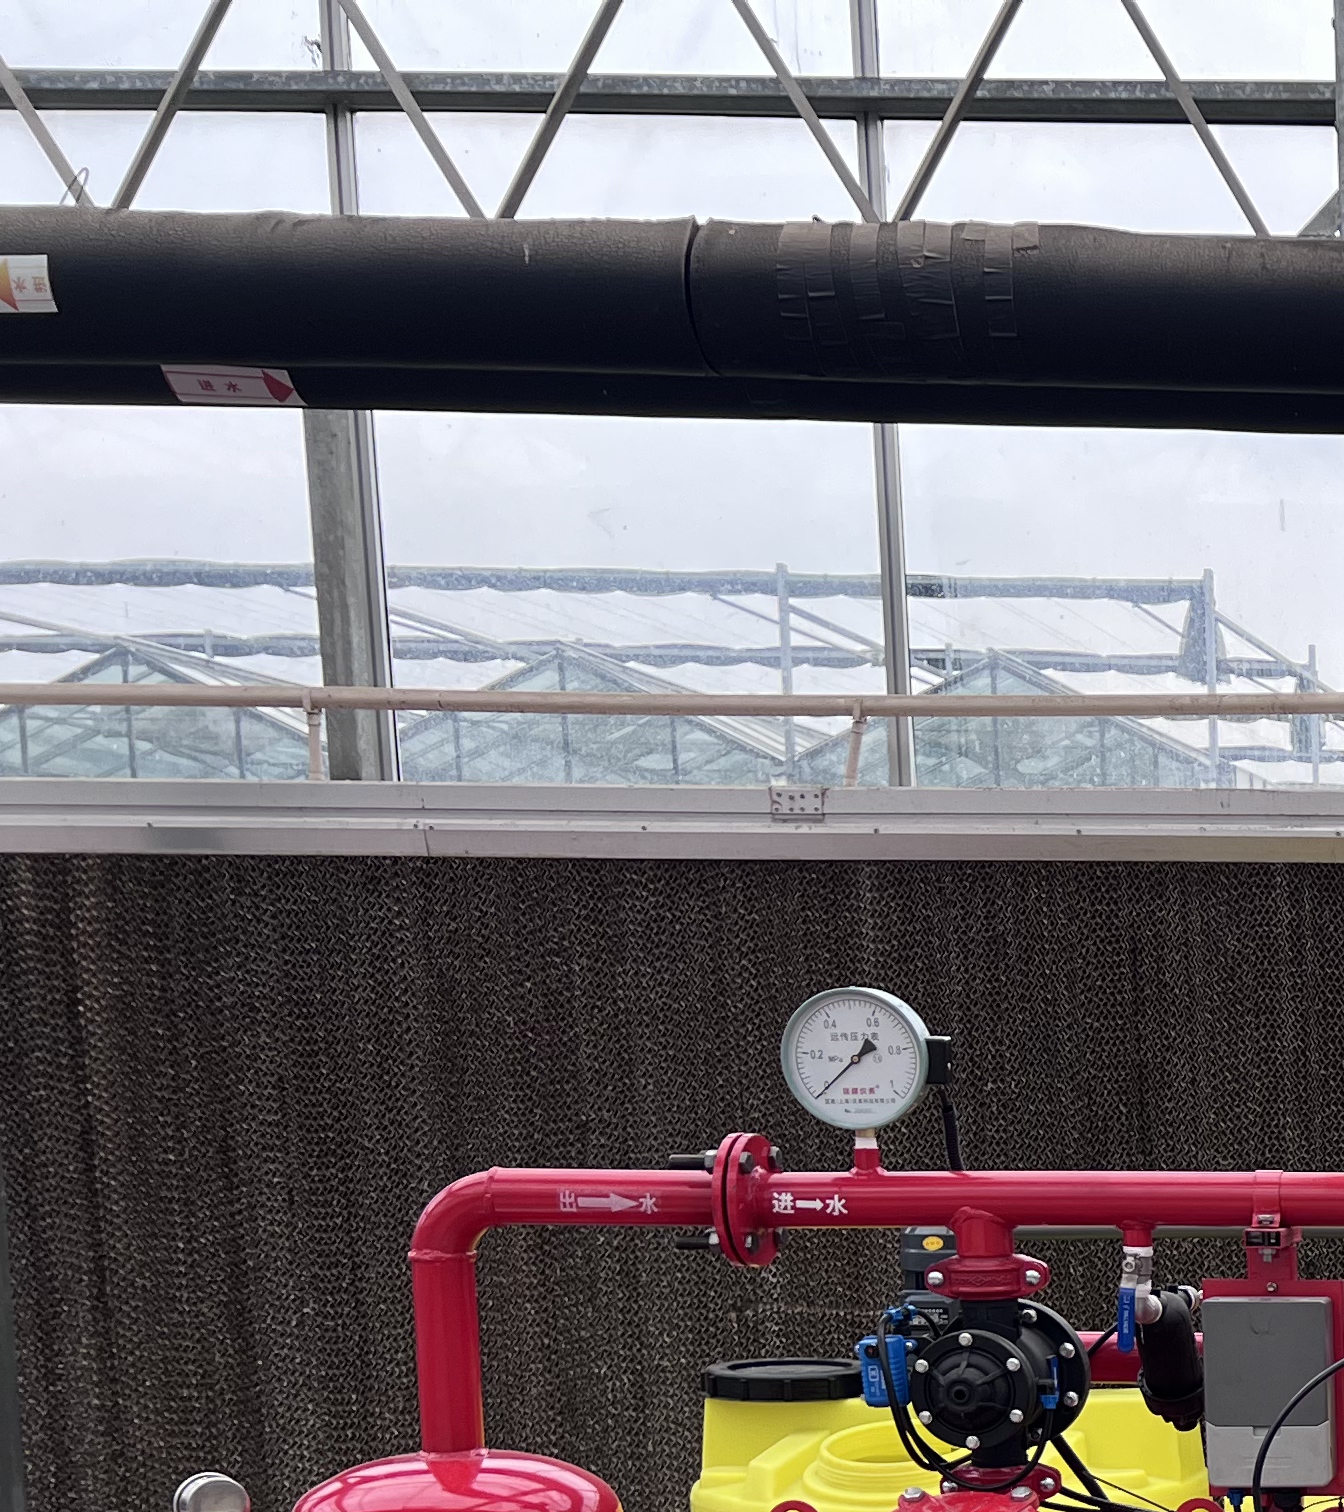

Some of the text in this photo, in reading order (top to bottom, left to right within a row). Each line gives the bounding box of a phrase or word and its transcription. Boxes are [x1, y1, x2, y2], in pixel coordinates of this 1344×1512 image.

[823, 1019, 837, 1029] 0.4
[866, 1018, 880, 1028] 0.6
[830, 1032, 880, 1042] 远传压力表
[809, 1050, 824, 1060] 0.2
[887, 1045, 902, 1055] 0.8
[828, 1055, 844, 1063] MPa
[772, 1192, 848, 1215] 进 水
